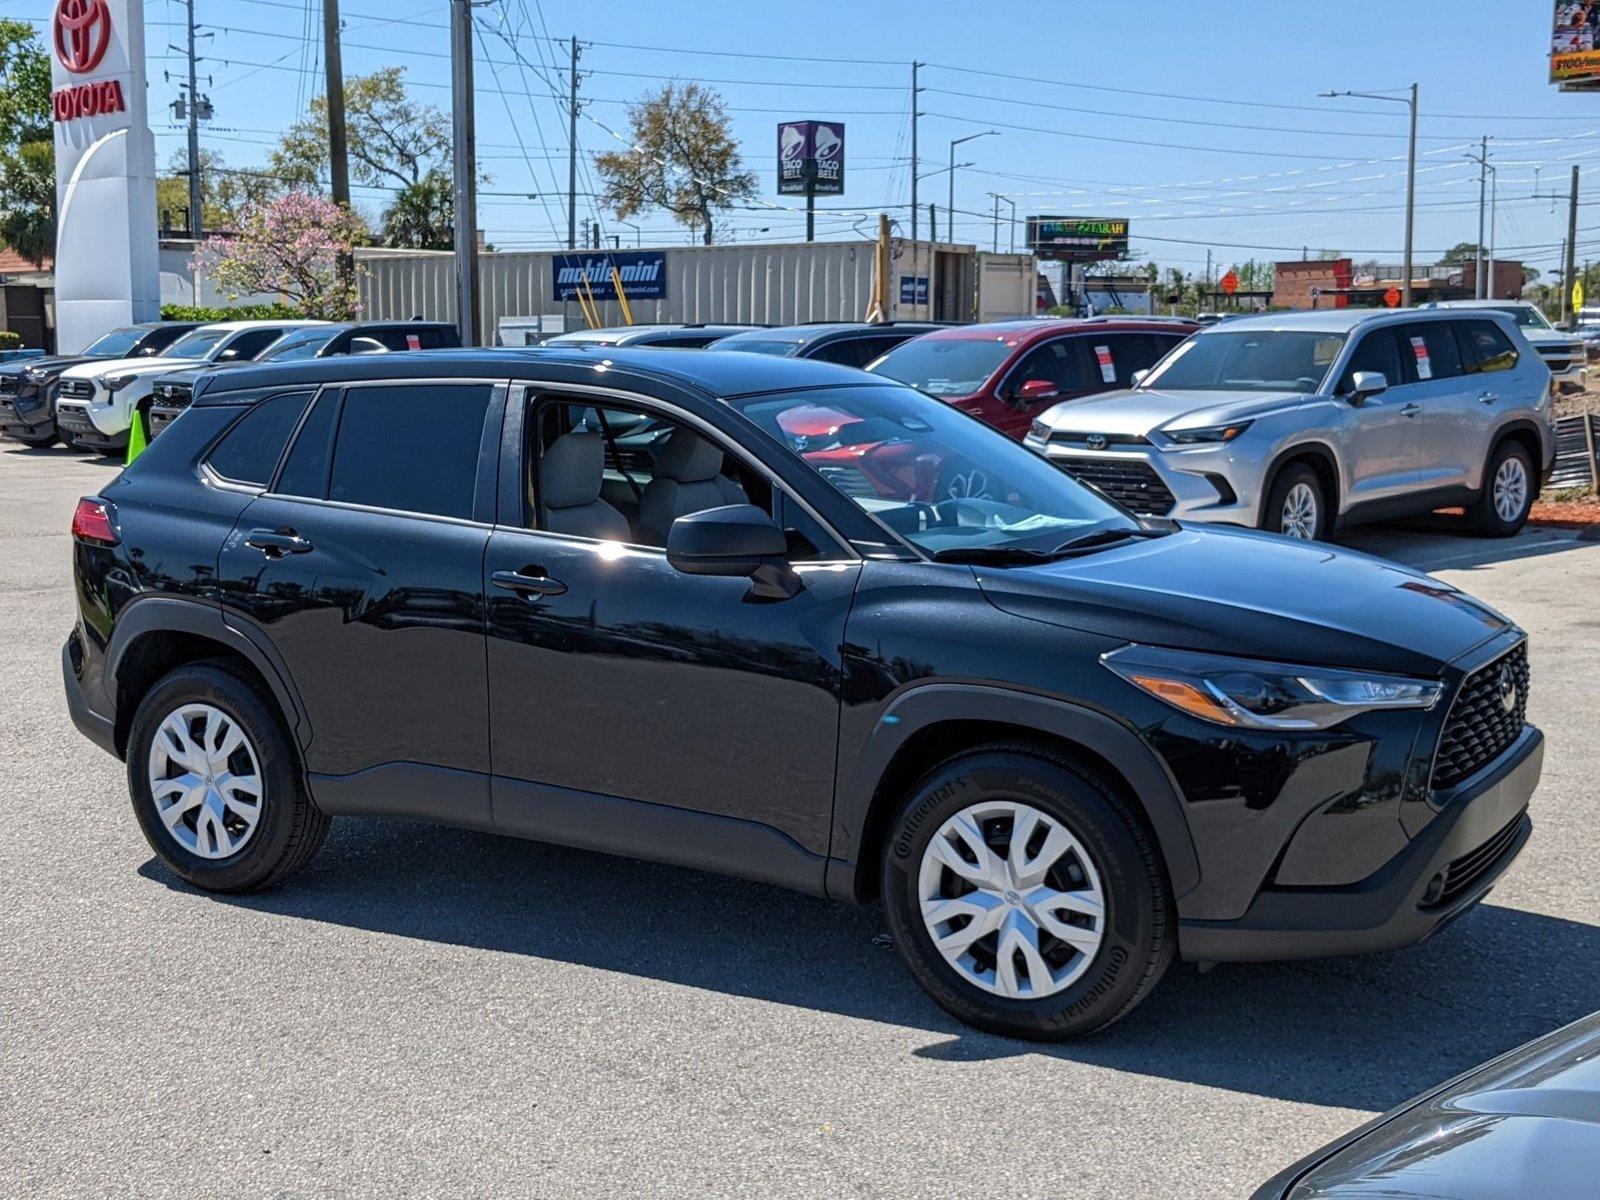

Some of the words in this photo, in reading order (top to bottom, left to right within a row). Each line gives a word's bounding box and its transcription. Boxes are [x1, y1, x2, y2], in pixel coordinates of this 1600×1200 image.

[50, 81, 125, 122] TOYOTA
[782, 160, 803, 170] TACO
[816, 160, 840, 170] TACO
[783, 169, 803, 179] BELL
[817, 170, 839, 180] BELL
[557, 259, 615, 284] mobile
[619, 260, 663, 282] mini
[895, 780, 957, 860] Continental
[1060, 943, 1129, 1021] Continental
